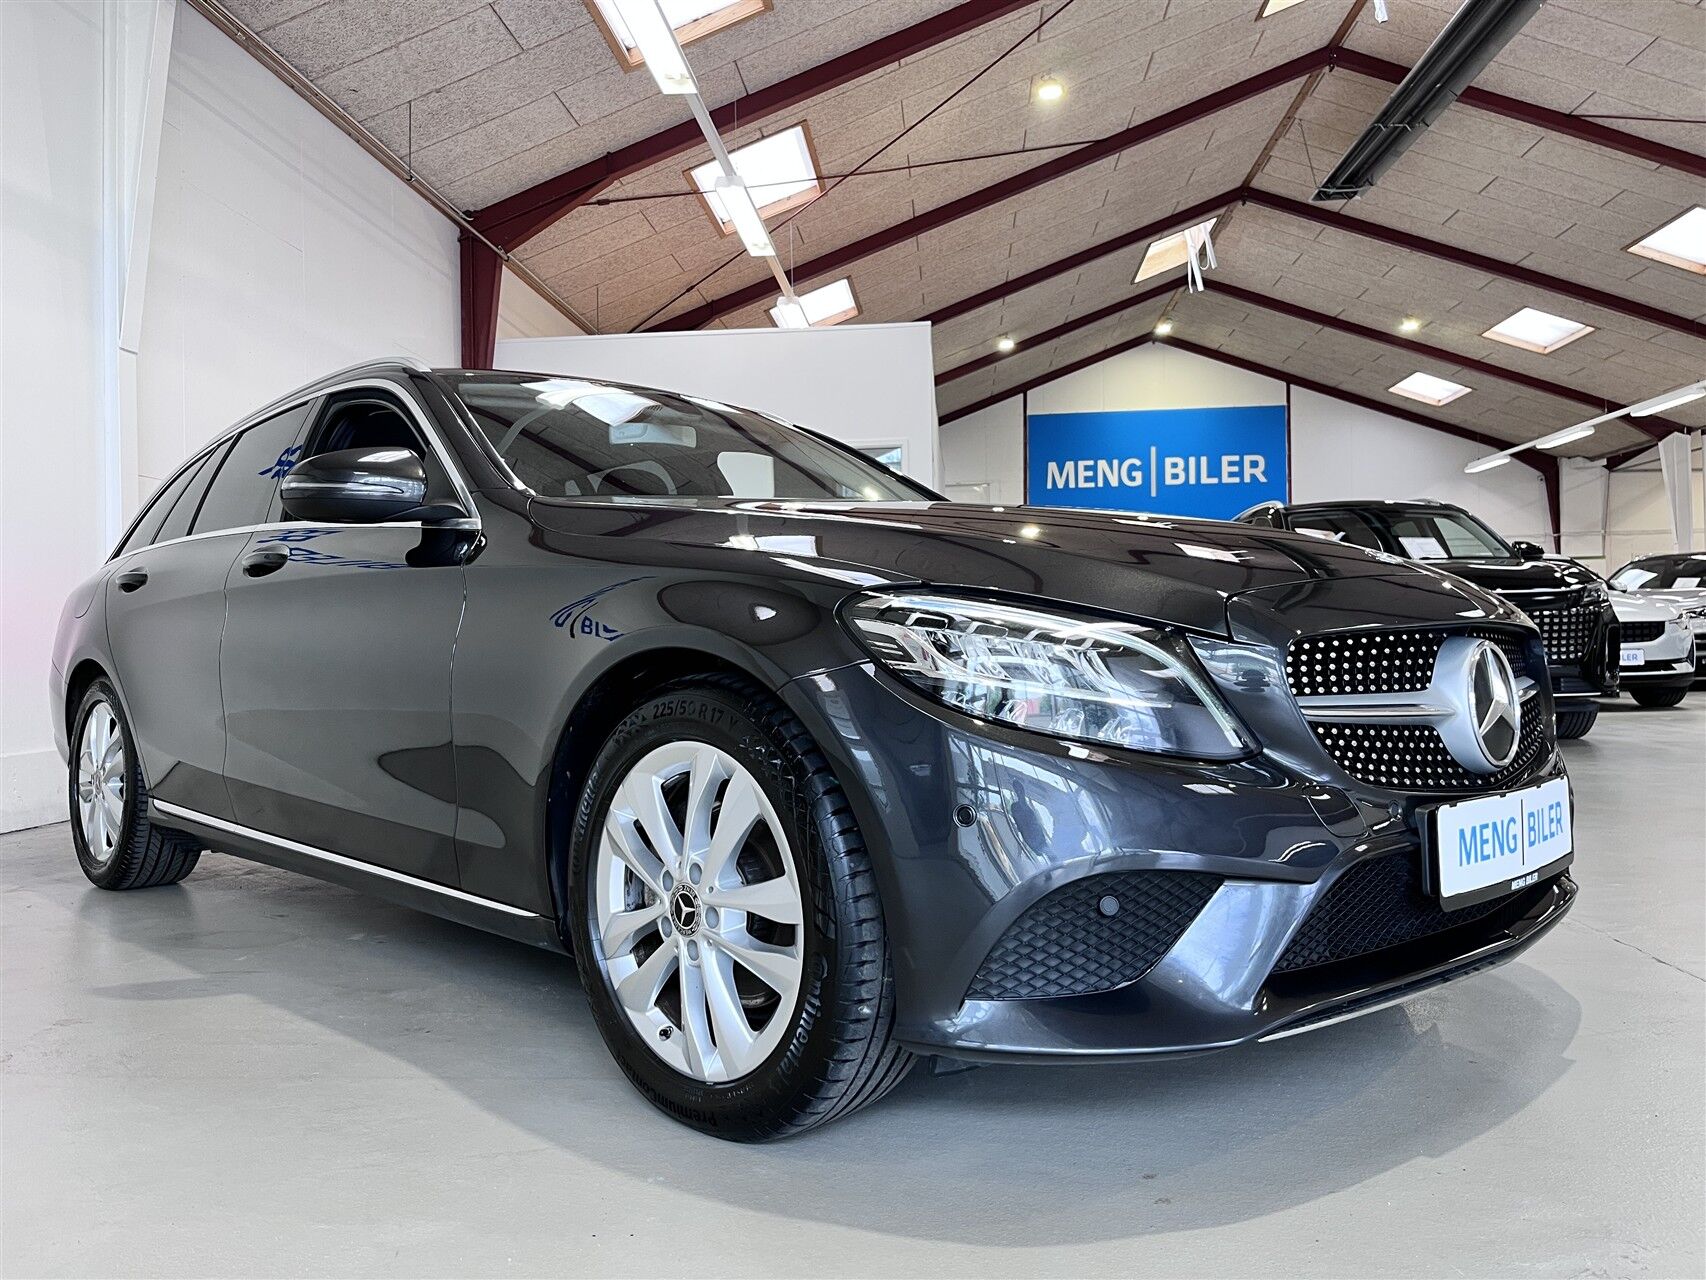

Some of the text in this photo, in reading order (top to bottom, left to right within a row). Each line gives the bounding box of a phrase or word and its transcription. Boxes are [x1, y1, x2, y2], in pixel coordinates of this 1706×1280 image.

[1046, 454, 1268, 490] MENG BILER
[1622, 653, 1638, 662] LER
[653, 699, 696, 719] 225/50
[711, 707, 725, 725] 17
[1458, 801, 1564, 867] MENG BILER
[777, 951, 829, 1087] Continental
